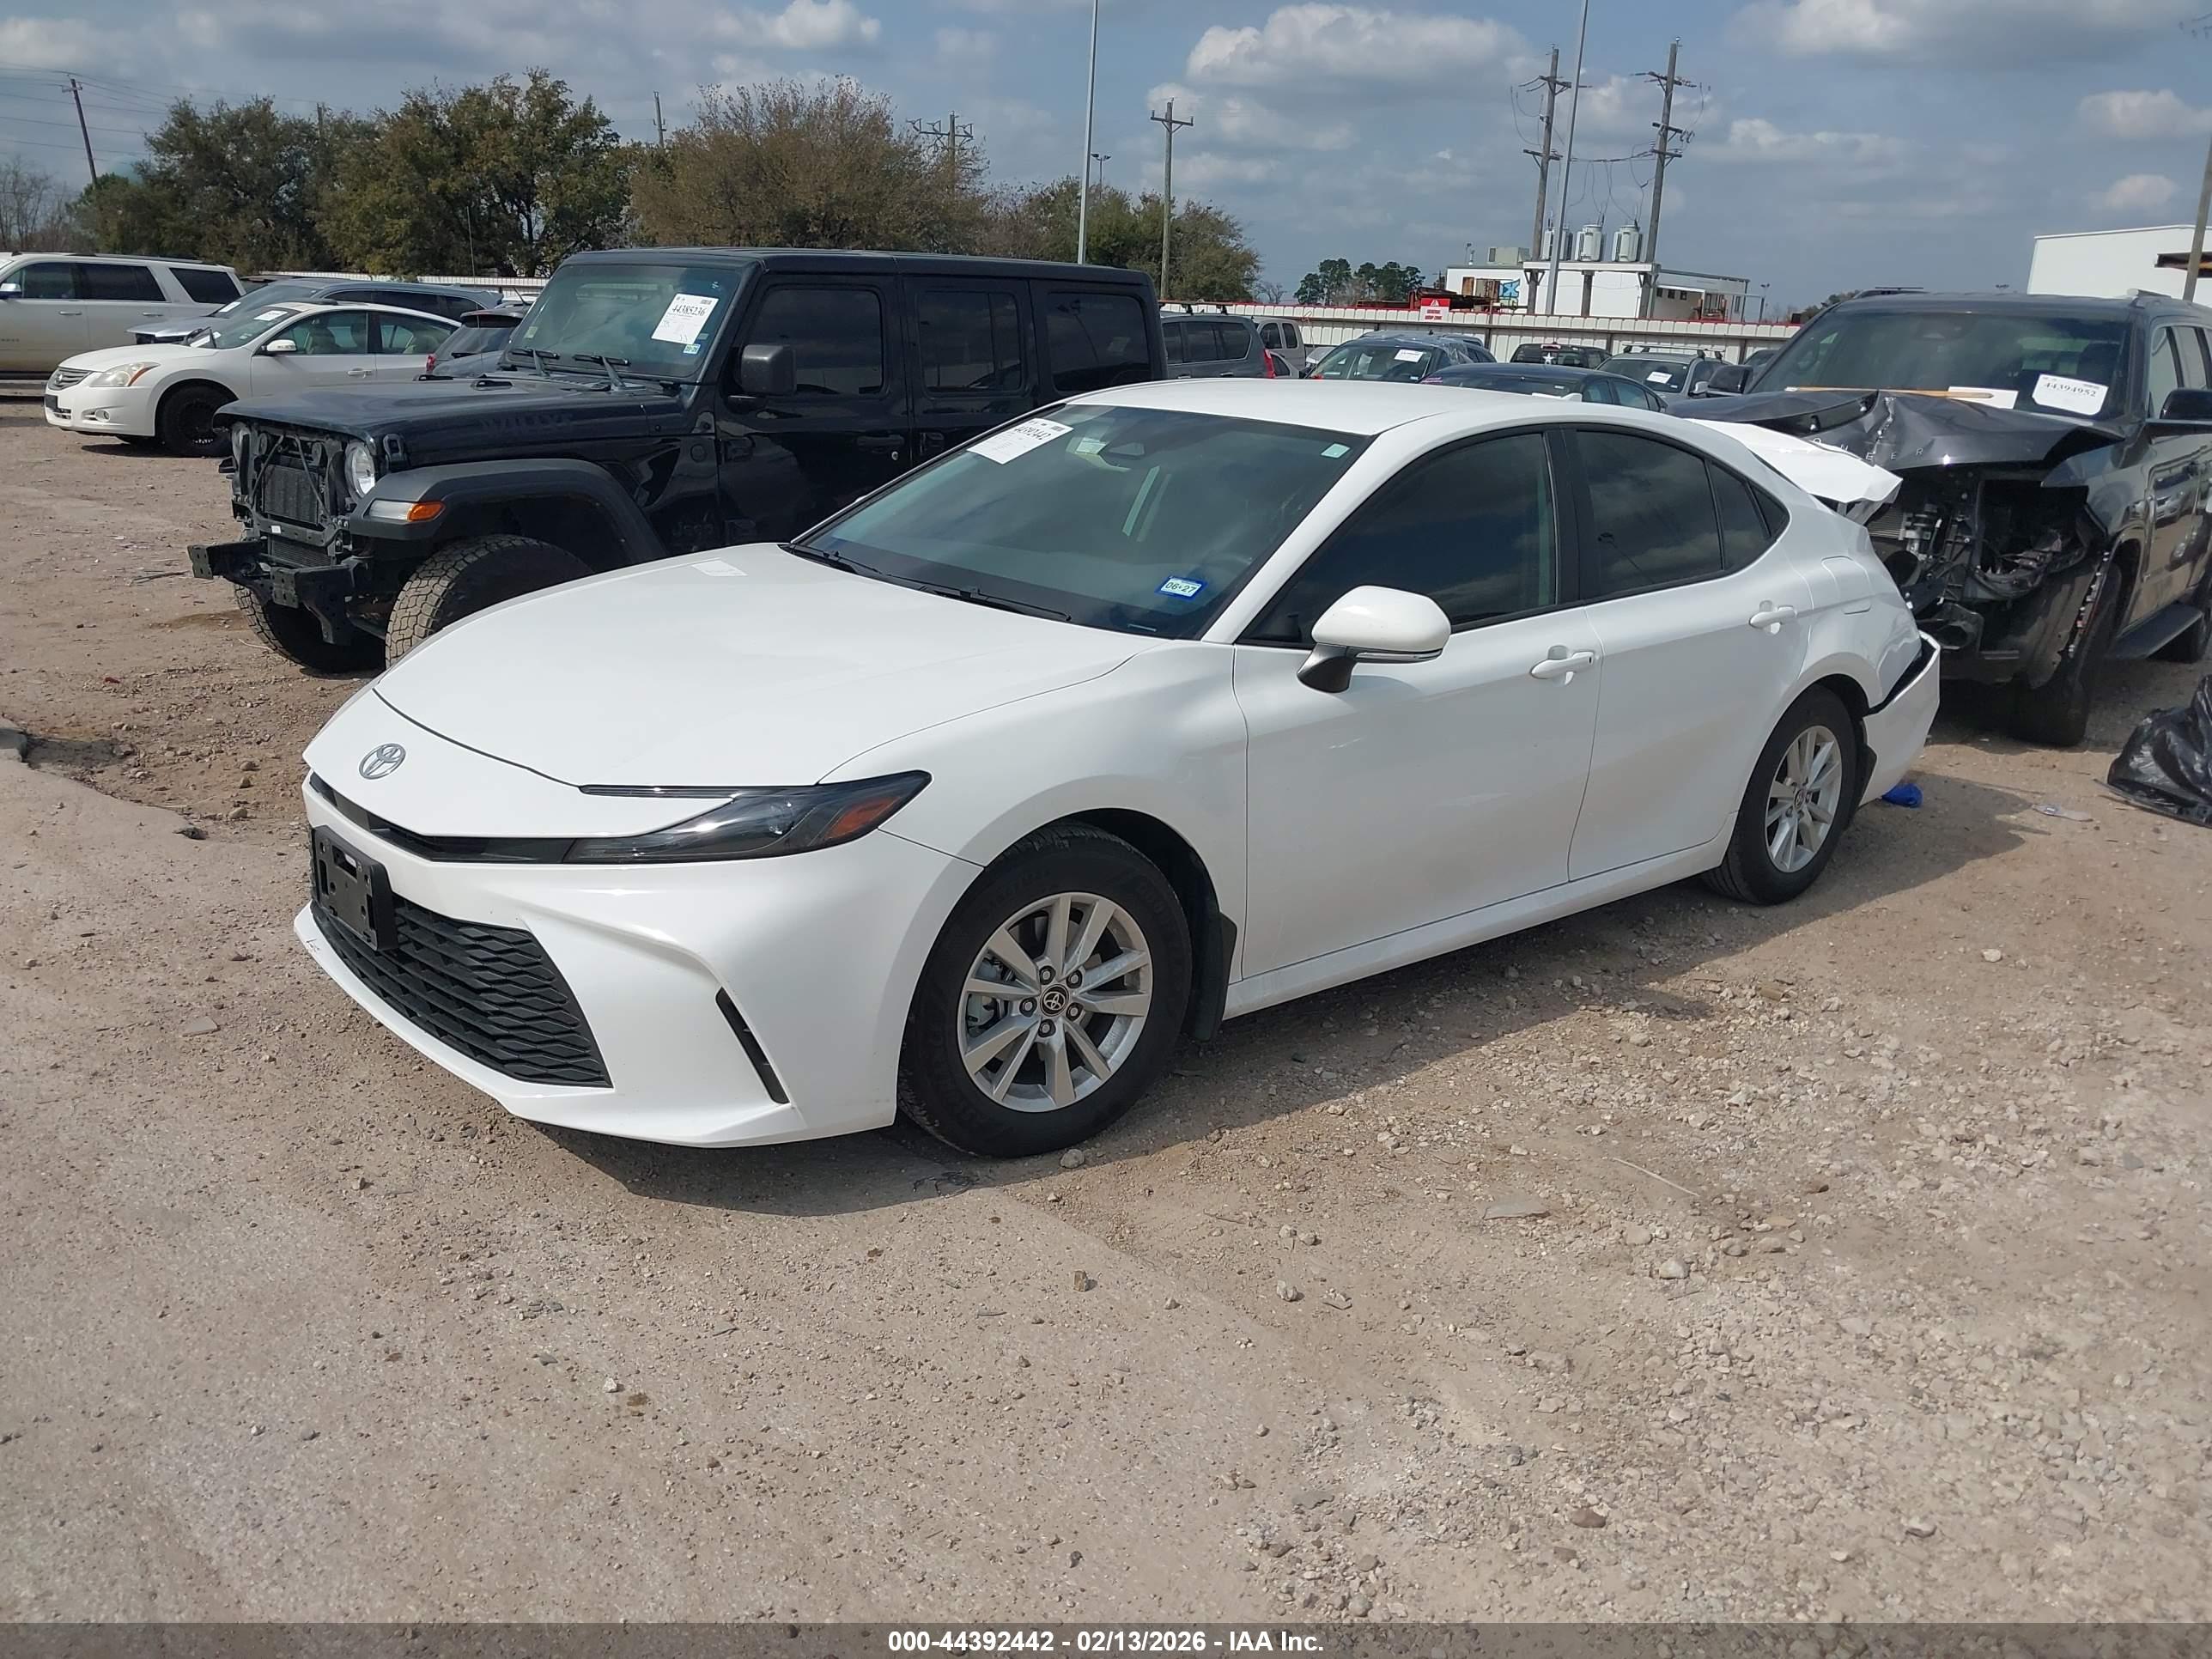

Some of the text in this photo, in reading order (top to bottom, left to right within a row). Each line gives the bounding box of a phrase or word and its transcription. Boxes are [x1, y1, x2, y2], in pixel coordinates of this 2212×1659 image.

[672, 304, 707, 317] 44385236
[2045, 382, 2096, 398] 44394952
[1014, 426, 1052, 441] 44392442
